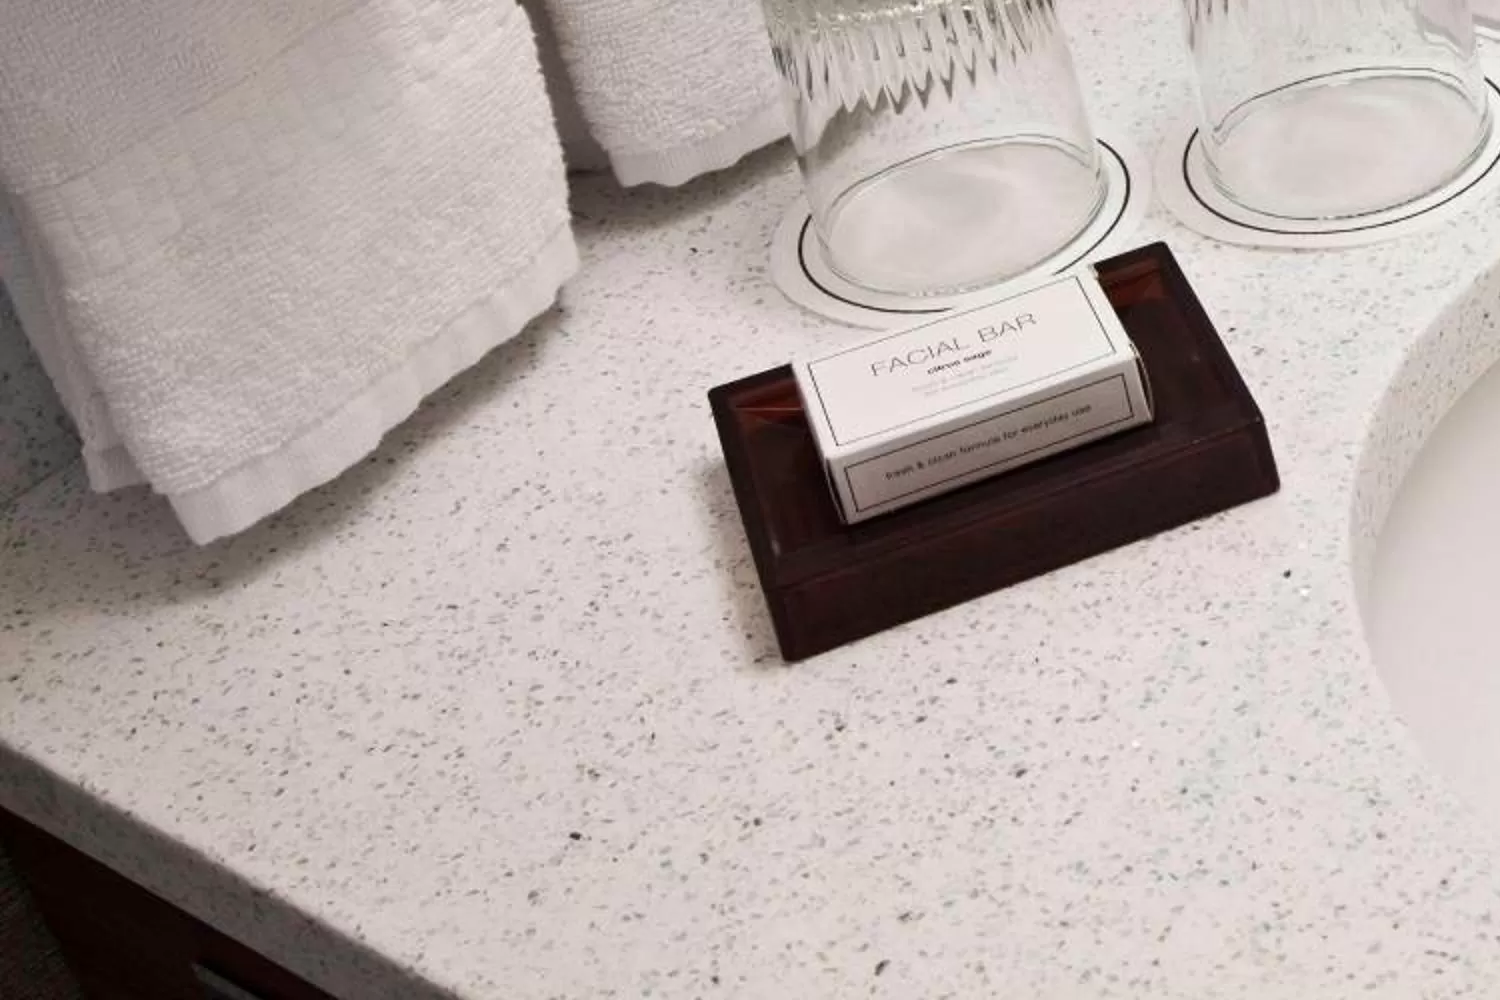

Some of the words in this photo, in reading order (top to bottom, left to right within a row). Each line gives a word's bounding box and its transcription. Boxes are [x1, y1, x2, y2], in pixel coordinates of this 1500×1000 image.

[869, 337, 971, 377] FACIAL
[977, 312, 1038, 343] BAR
[959, 435, 1001, 454] formula
[1003, 430, 1018, 441] for
[1020, 412, 1069, 433] everyday
[1071, 404, 1093, 417] use
